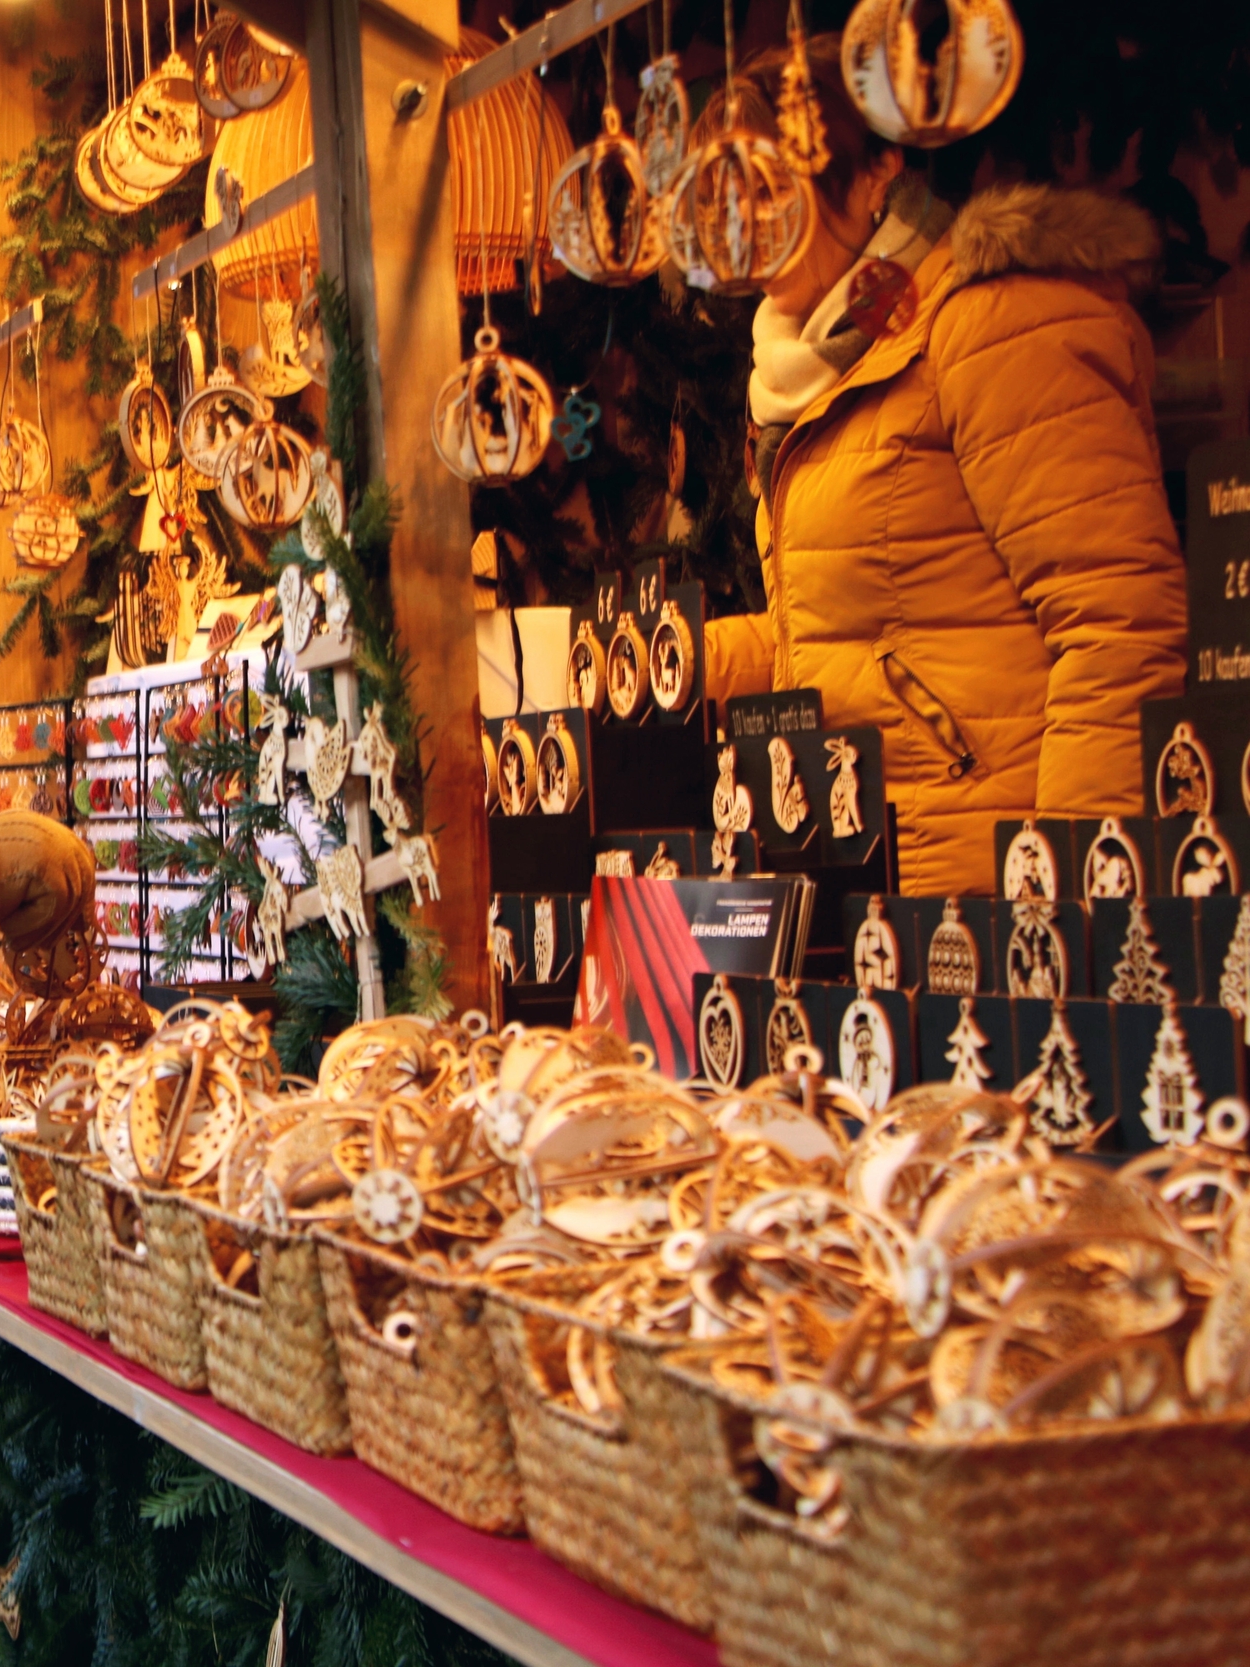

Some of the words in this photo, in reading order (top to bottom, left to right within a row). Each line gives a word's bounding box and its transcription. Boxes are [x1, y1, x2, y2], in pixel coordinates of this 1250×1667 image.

[1199, 649, 1212, 681] 10
[728, 913, 770, 926] LAMPEN
[691, 923, 767, 938] DEKORATIONEN
